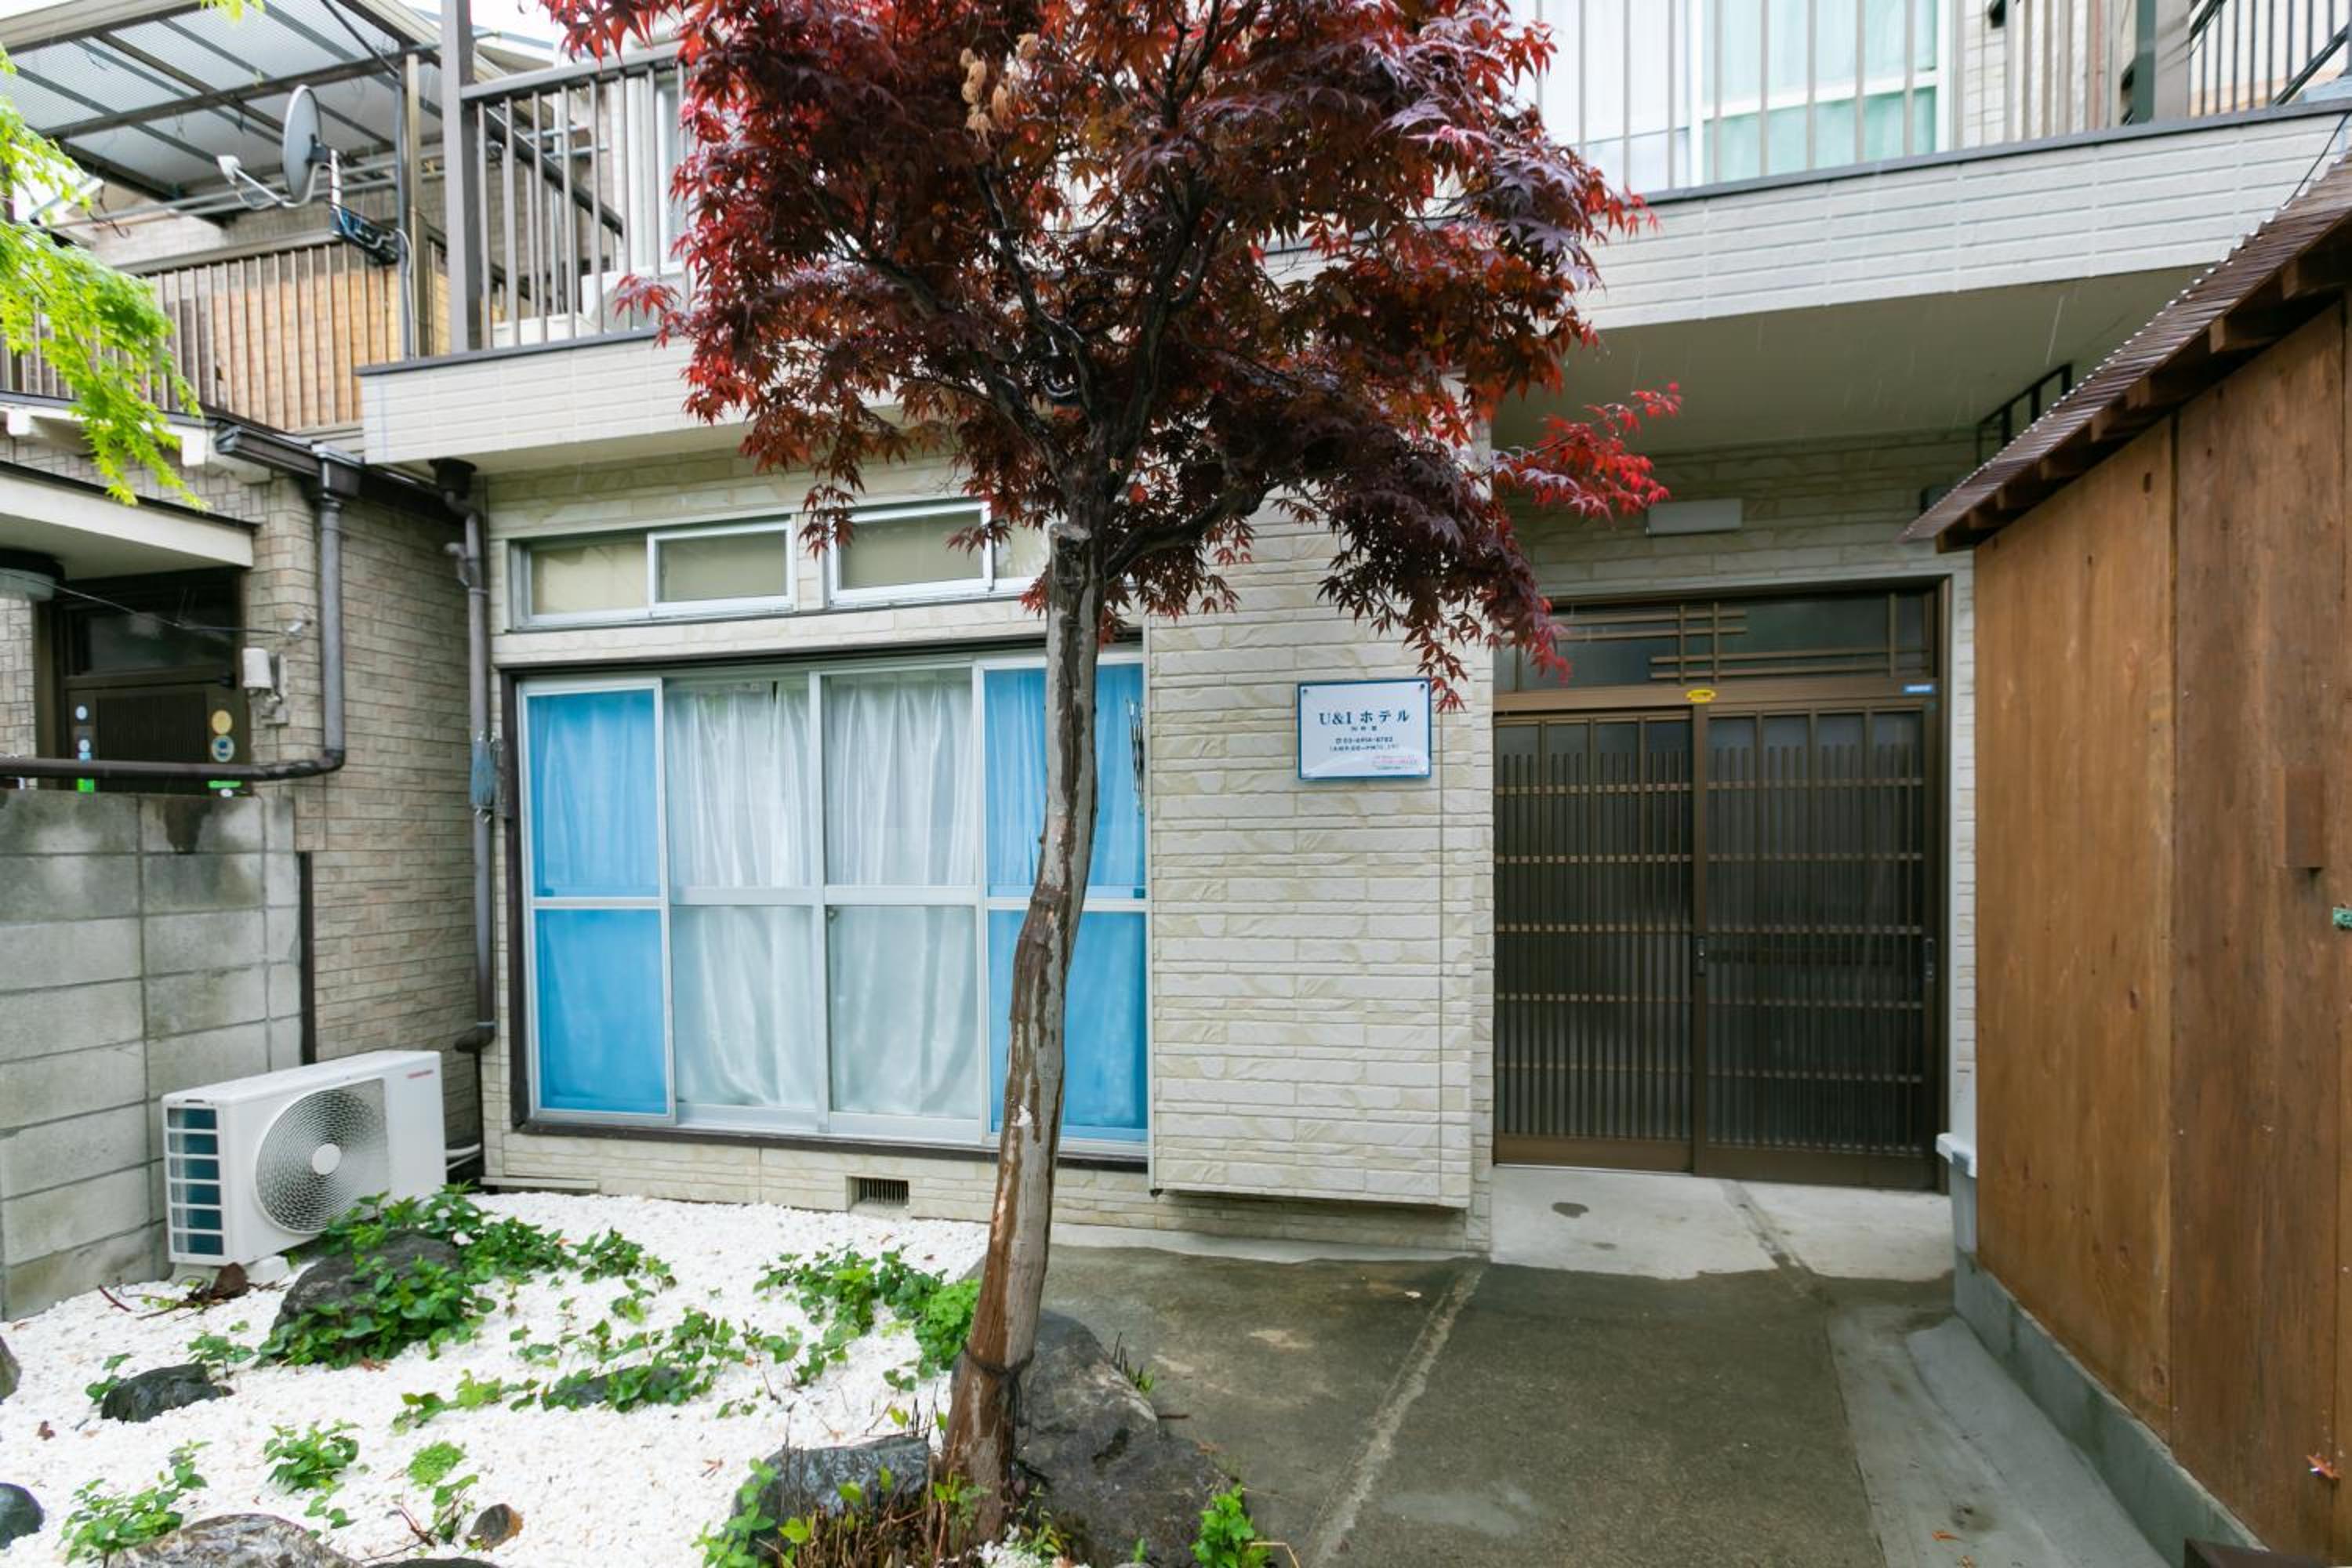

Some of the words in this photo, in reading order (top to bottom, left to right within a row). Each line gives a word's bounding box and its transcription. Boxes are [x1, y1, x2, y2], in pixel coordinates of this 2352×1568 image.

[1319, 711, 1351, 724] U&I
[1360, 710, 1410, 723] ホテル
